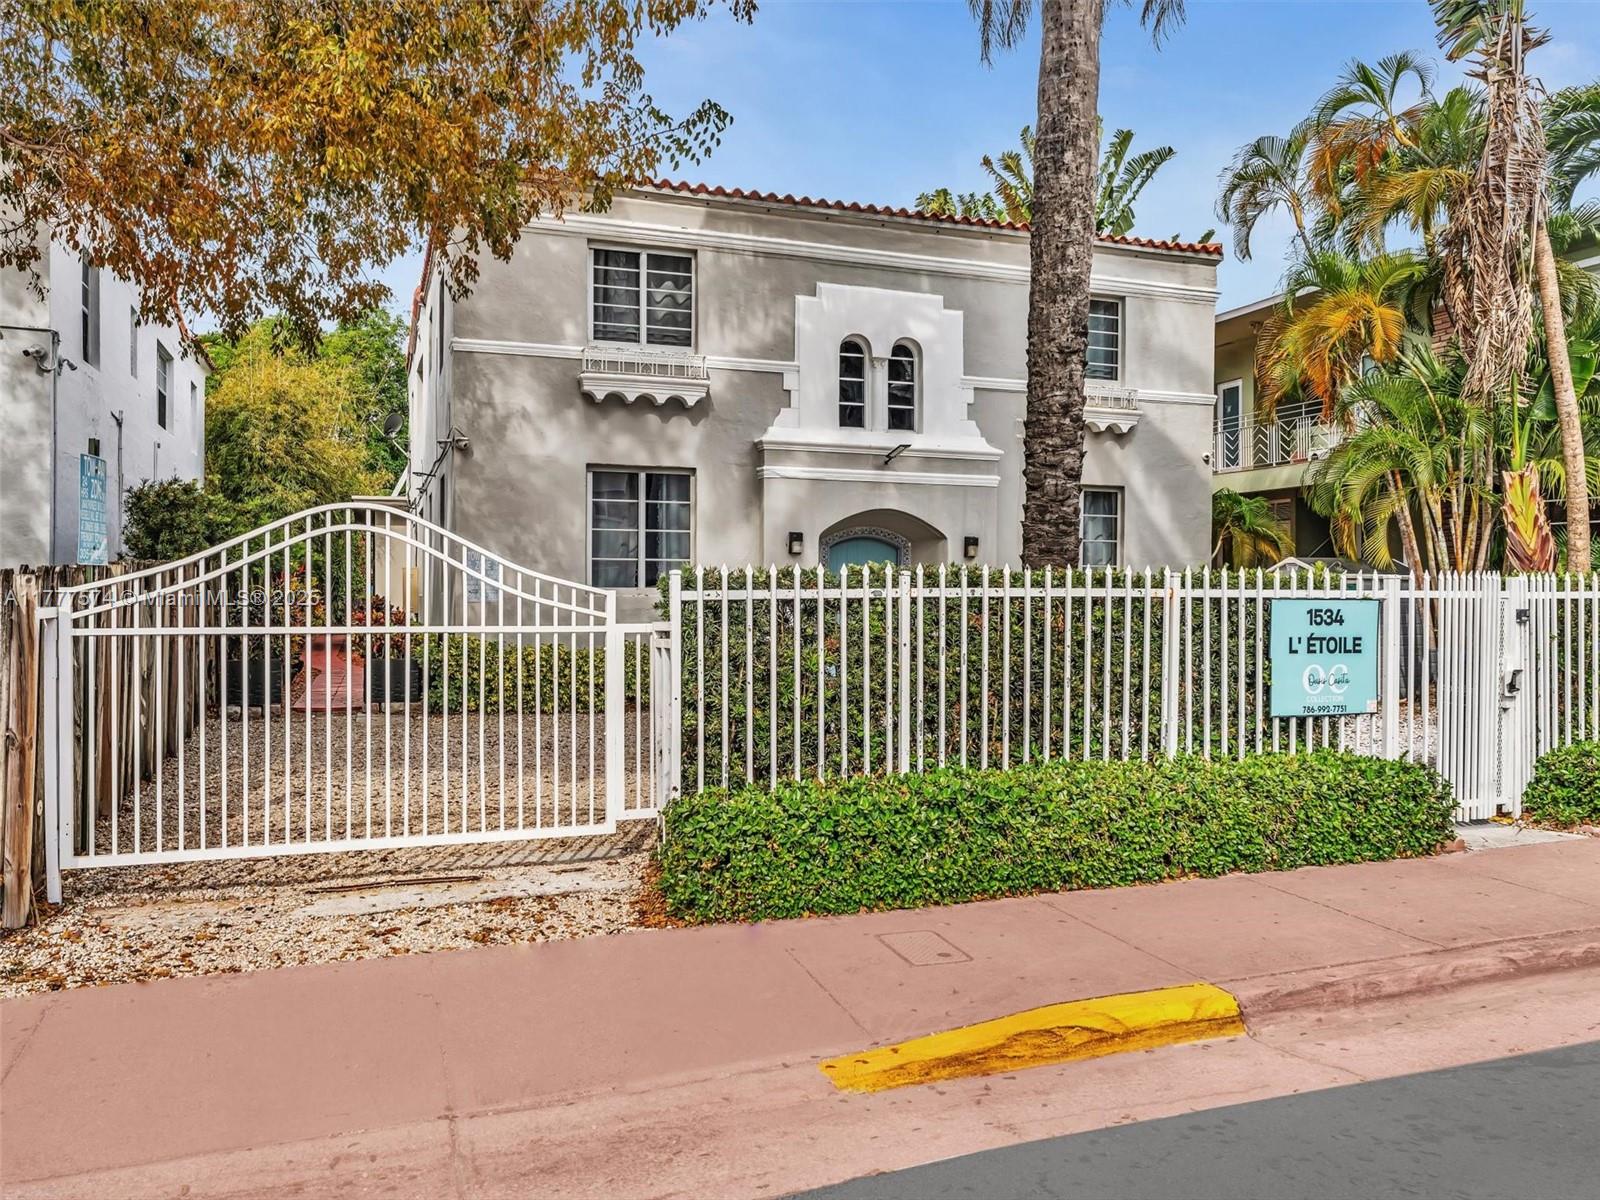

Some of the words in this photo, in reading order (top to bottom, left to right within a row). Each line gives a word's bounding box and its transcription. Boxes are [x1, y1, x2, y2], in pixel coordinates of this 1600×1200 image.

[1307, 609, 1344, 626] 1534
[1307, 633, 1362, 654] ÉTOILE
[1302, 705, 1347, 714] 786-992-7751
